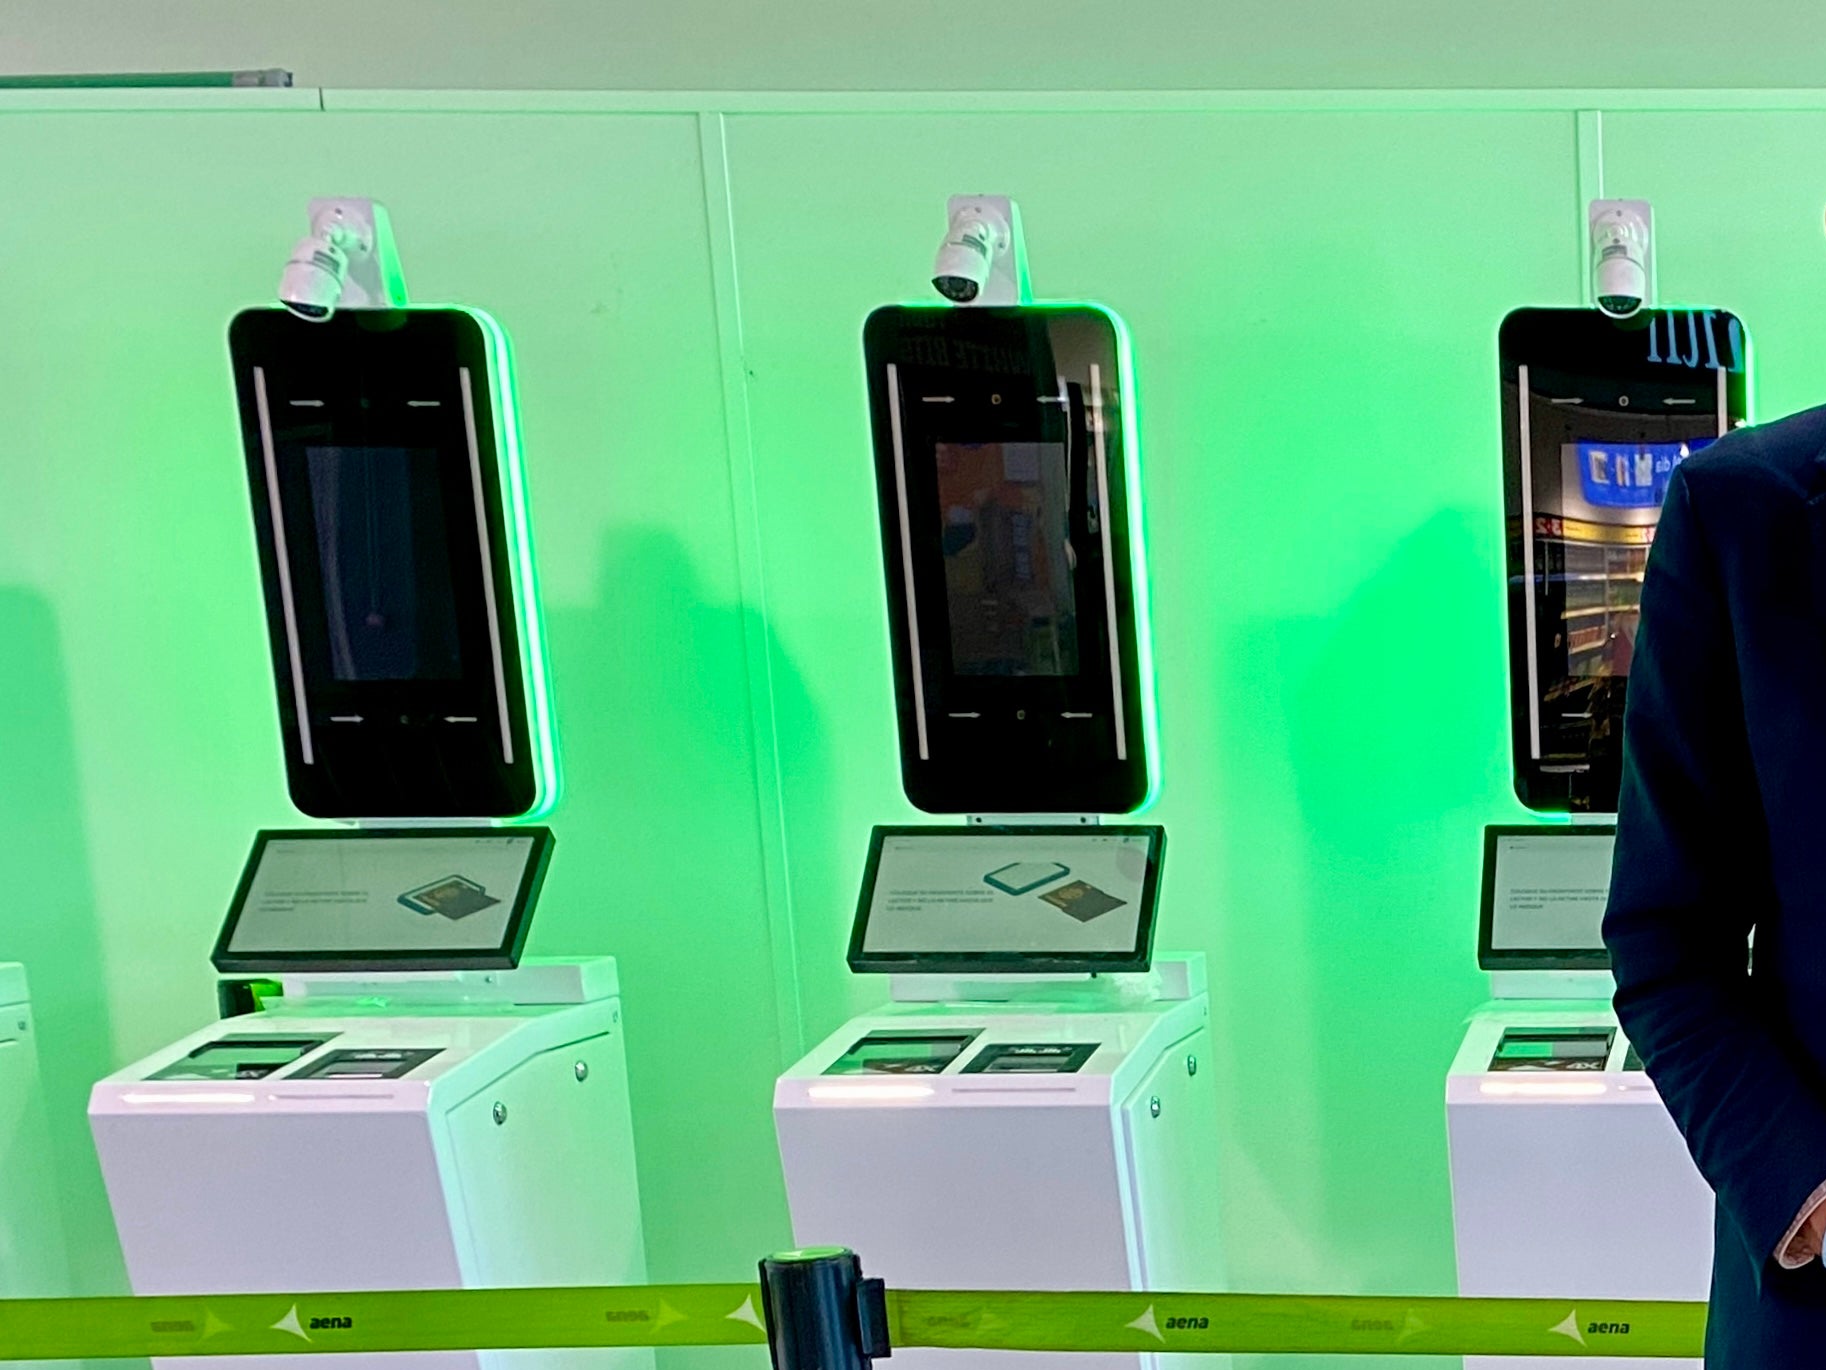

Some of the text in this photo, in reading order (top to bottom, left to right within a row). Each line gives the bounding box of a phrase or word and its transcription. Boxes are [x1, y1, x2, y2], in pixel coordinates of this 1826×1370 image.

[309, 1316, 353, 1329] aena
[1166, 1316, 1210, 1329] aena
[1587, 1322, 1631, 1334] aena
